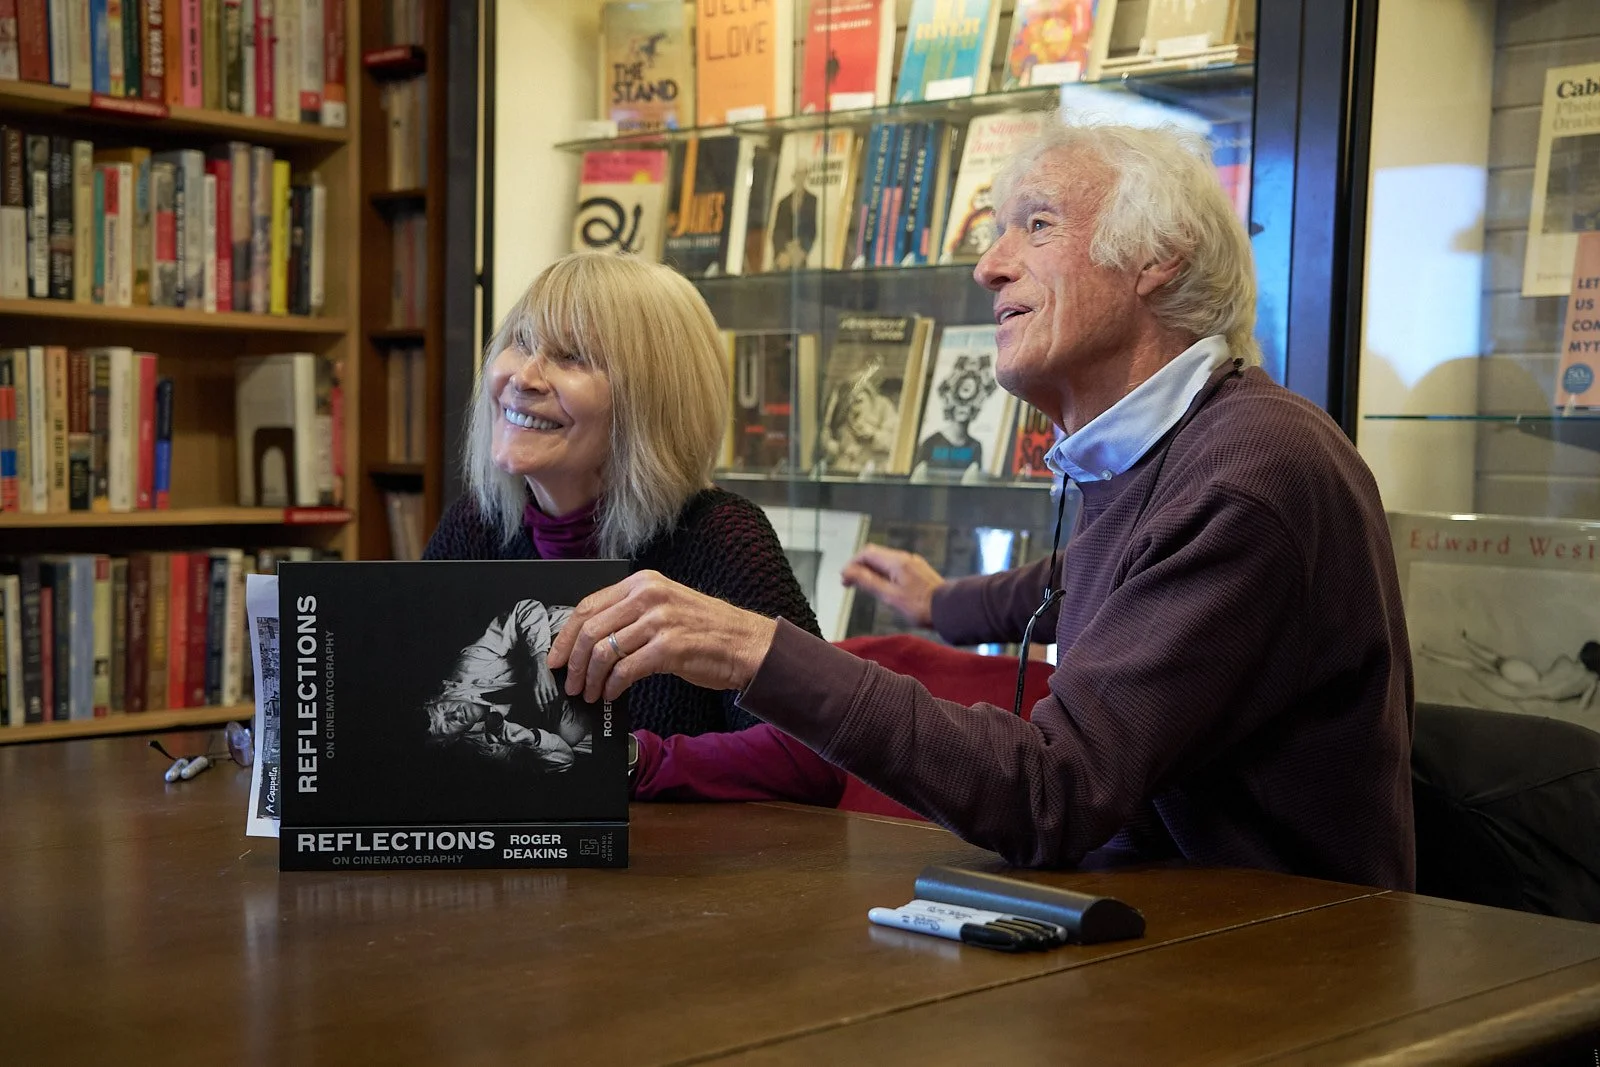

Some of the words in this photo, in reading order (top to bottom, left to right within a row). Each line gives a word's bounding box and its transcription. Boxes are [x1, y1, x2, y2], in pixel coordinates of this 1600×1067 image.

[705, 20, 769, 61] LOVE
[613, 62, 644, 82] THE
[613, 79, 679, 104] STAND
[1556, 78, 1600, 98] Cab
[1575, 298, 1594, 311] US
[1409, 528, 1511, 555] Edward
[296, 595, 318, 793] REFLECTIONS
[325, 630, 335, 740] CINEMATOGRAPHY
[325, 742, 335, 759] ON
[266, 766, 279, 803] Cappella
[265, 803, 275, 814] A
[297, 831, 495, 852] REFLECTIONS
[510, 834, 562, 845] ROGER
[332, 854, 350, 865] ON
[352, 854, 464, 865] CINEMATOGRAPHY
[503, 848, 568, 859] DEAKINS
